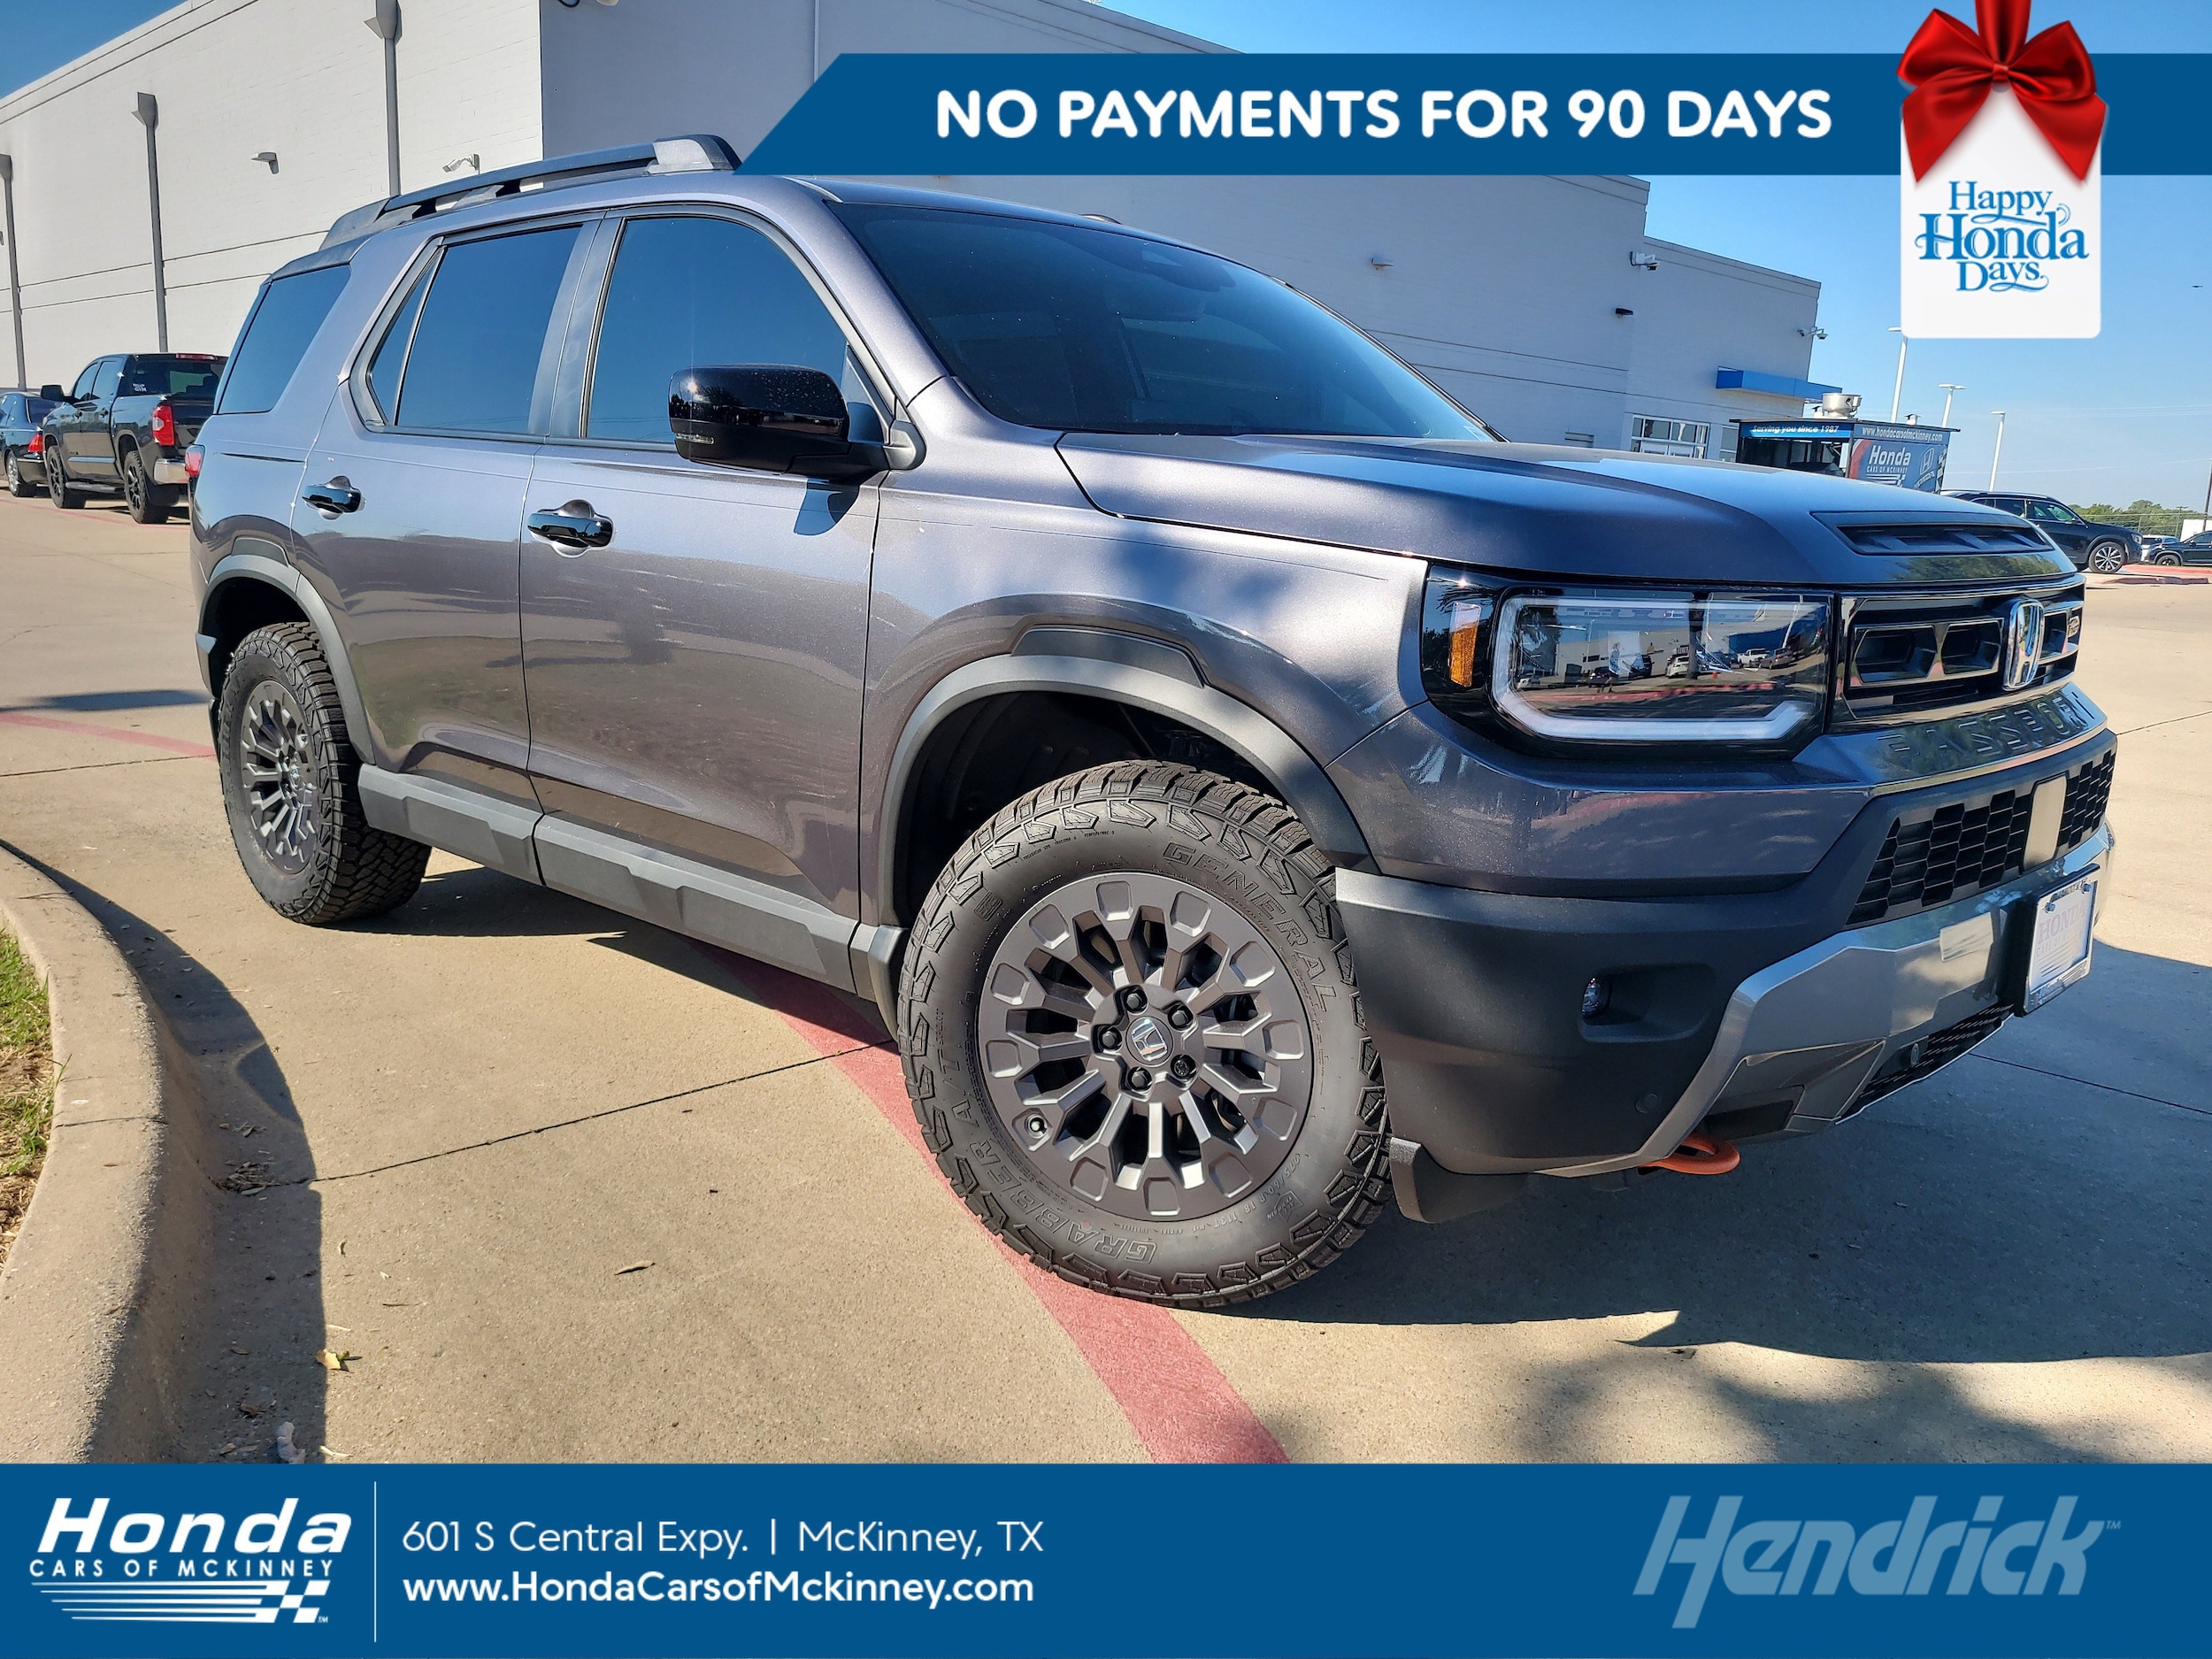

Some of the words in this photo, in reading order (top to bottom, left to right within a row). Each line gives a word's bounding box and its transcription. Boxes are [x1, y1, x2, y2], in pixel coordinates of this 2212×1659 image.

[1752, 425, 1779, 434] Serving
[1868, 444, 1911, 466] Honda
[1163, 841, 1337, 1012] GENERAL
[969, 1139, 1157, 1263] GRABBER
